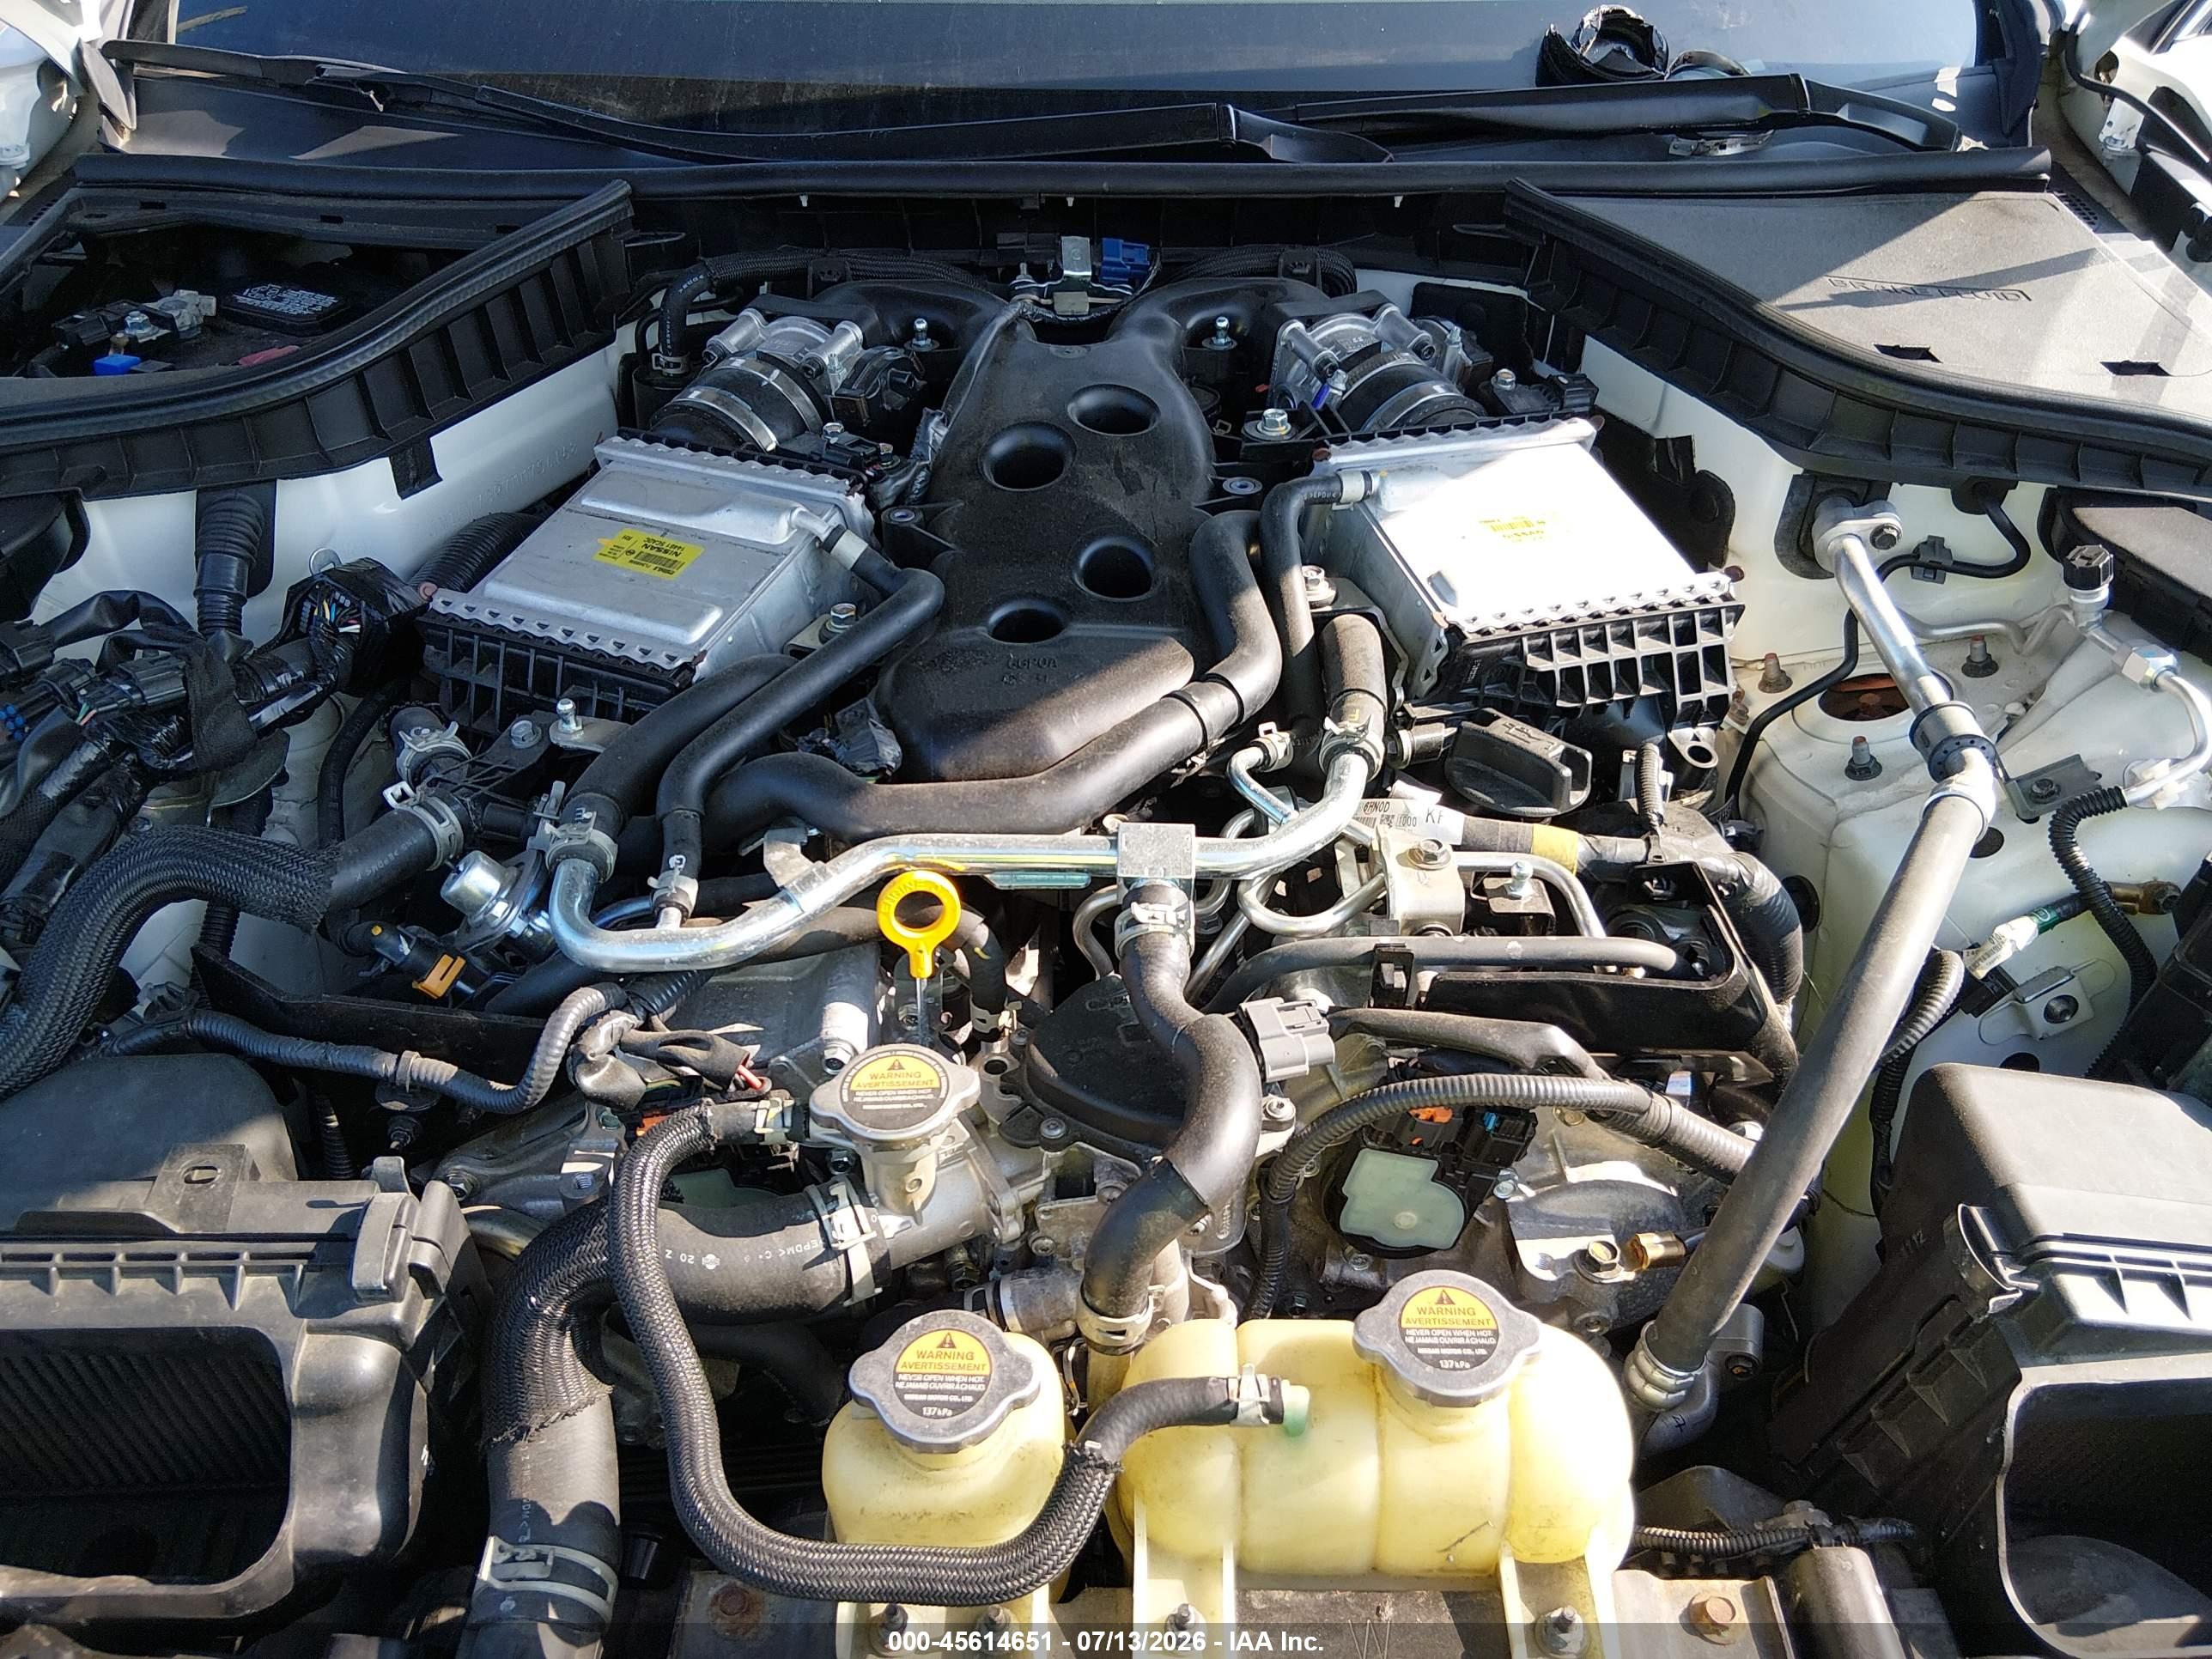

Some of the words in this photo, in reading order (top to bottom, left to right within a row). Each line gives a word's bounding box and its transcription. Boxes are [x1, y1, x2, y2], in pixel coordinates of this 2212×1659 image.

[1826, 277, 1930, 296] BRAKE
[1936, 288, 2022, 301] FLUID
[641, 543, 682, 557] NISSAN
[869, 1071, 922, 1080] WARNING
[855, 1079, 935, 1088] AVERTISSEMENT
[1416, 1307, 1476, 1316] WARNING
[1405, 1317, 1492, 1327] AVERTISSEMENT
[916, 1350, 975, 1361] WARNING
[900, 1361, 987, 1371] AVERTISSEMENT
[922, 1407, 938, 1416] 137
